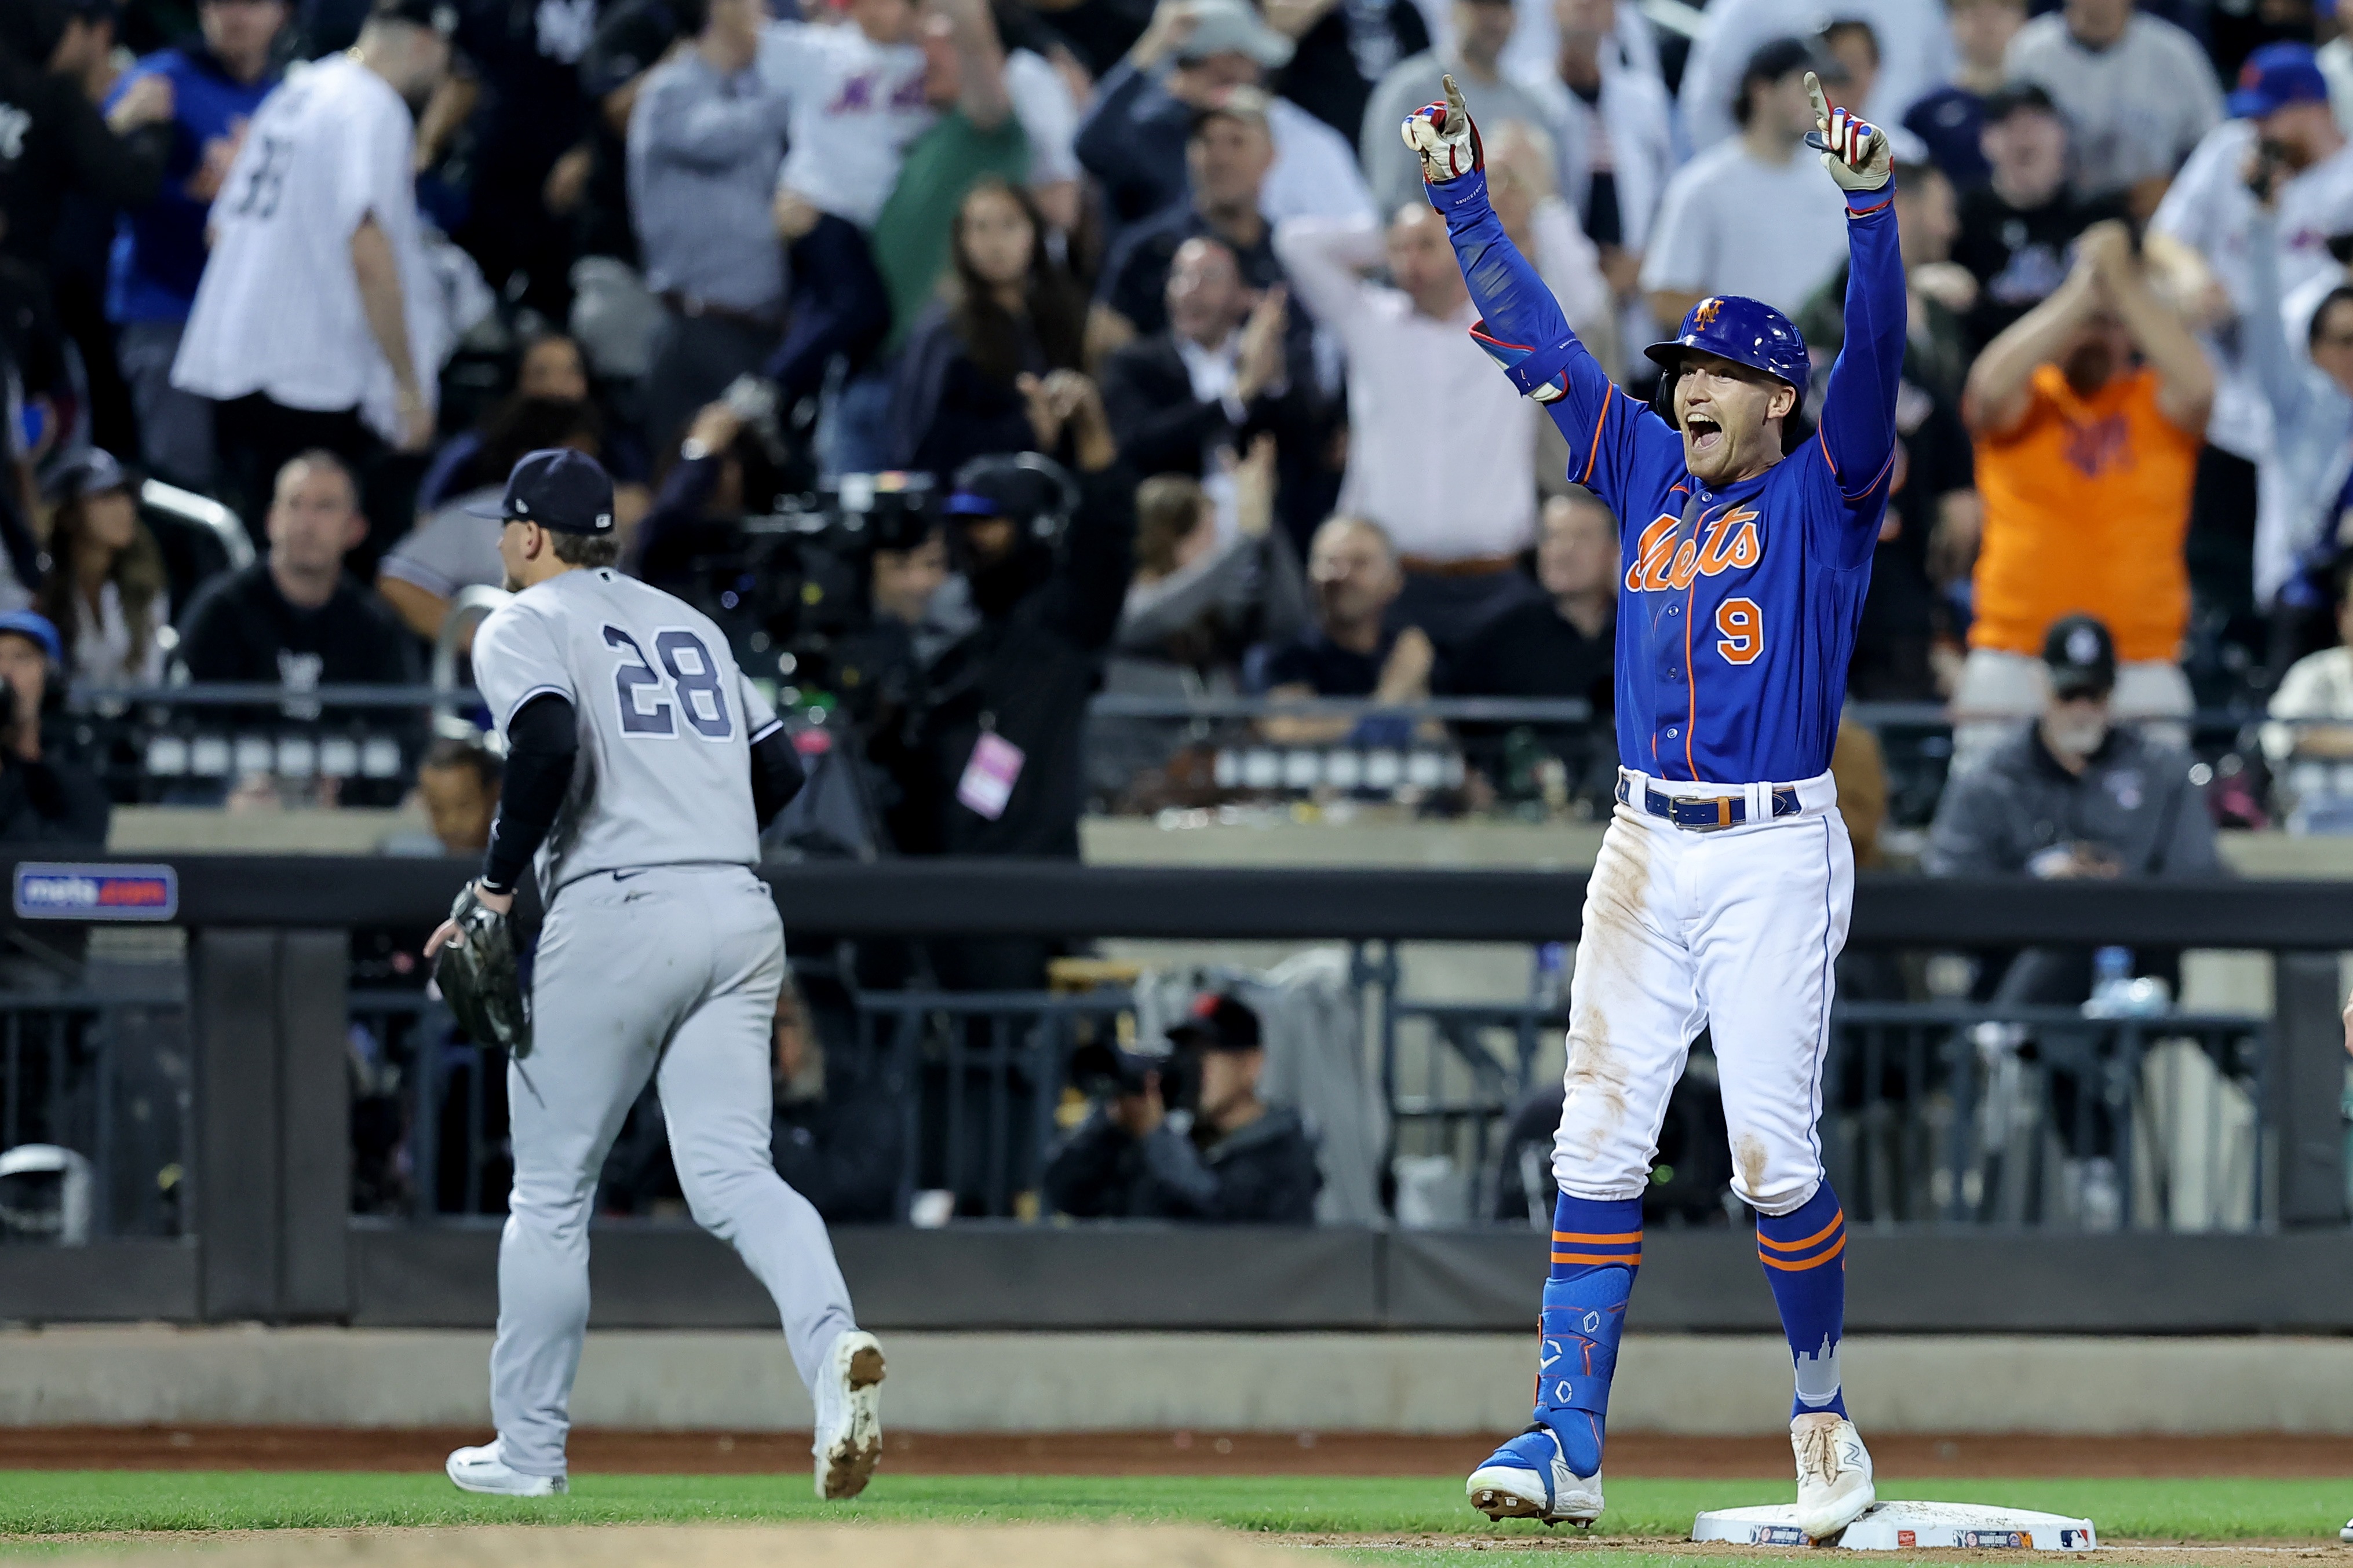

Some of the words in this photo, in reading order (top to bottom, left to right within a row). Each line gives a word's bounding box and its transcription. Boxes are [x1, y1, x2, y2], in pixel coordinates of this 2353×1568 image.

[1625, 505, 1760, 593] Mets
[1715, 597, 1764, 665] 9
[599, 621, 736, 743] 28
